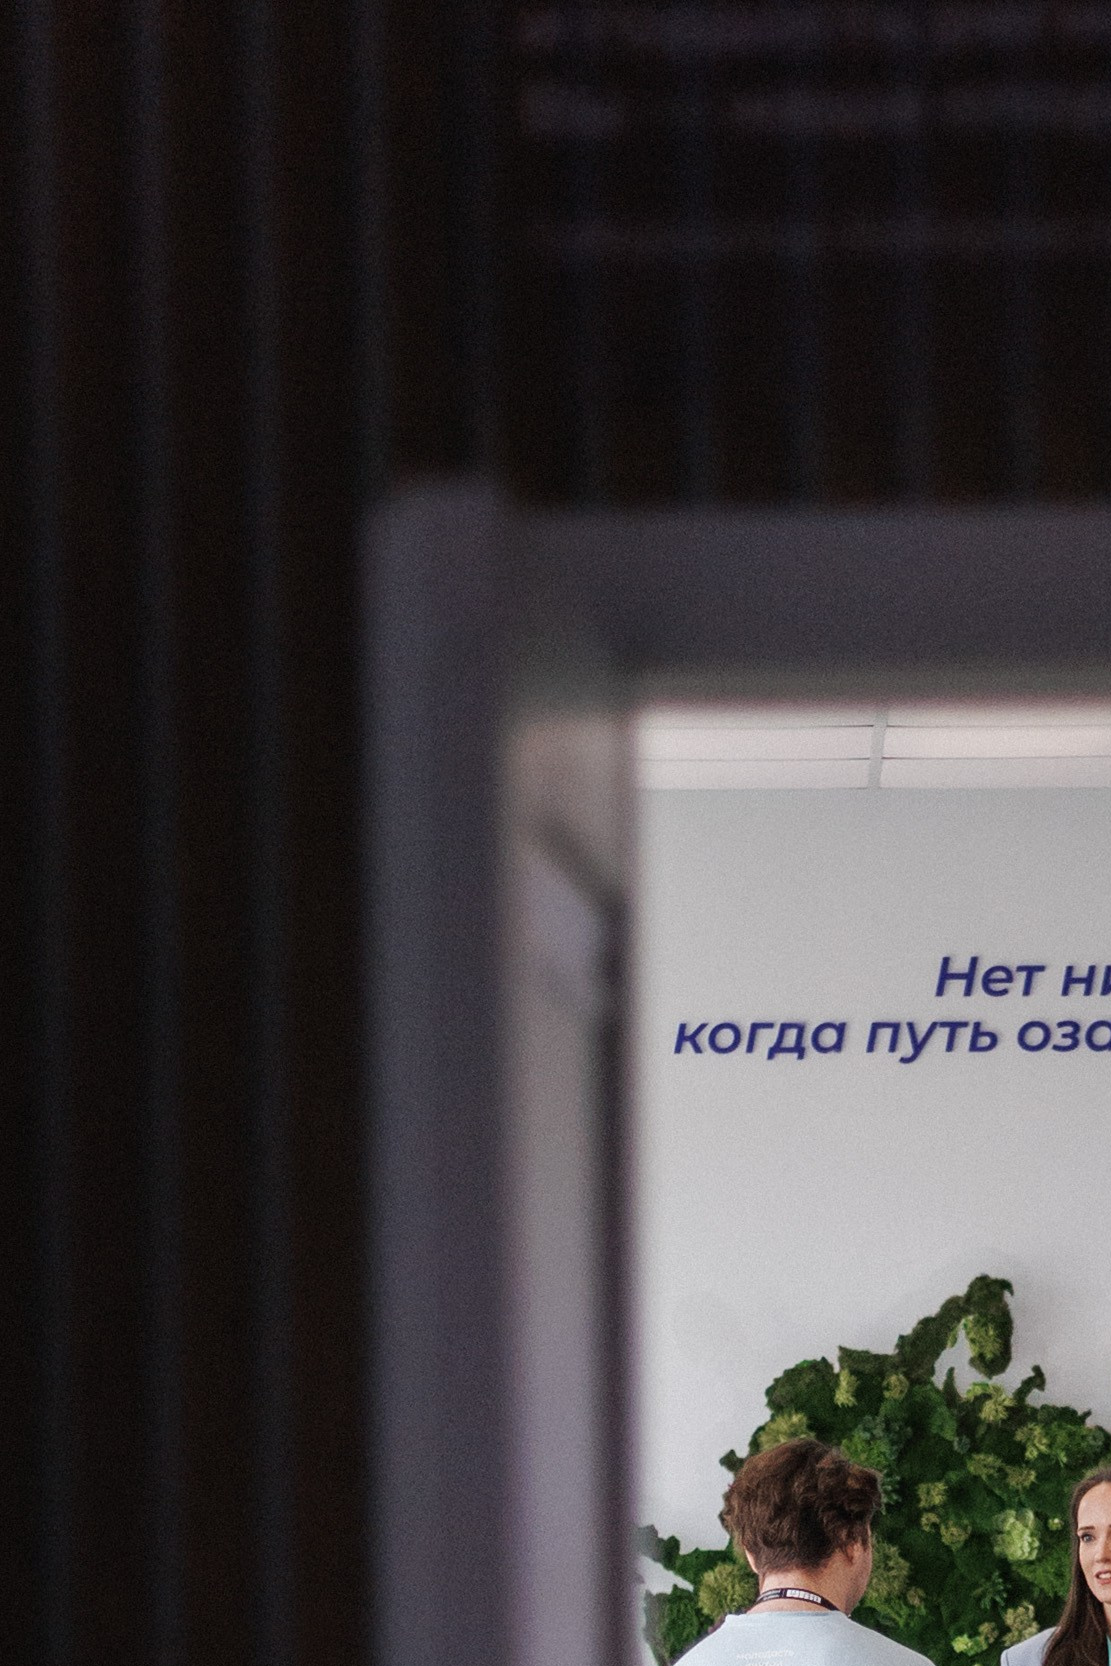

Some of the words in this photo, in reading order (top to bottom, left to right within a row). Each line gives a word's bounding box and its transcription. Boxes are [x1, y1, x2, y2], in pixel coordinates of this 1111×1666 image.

[937, 956, 1047, 998] Нет
[675, 1021, 850, 1062] когда
[867, 1020, 1003, 1066] путь
